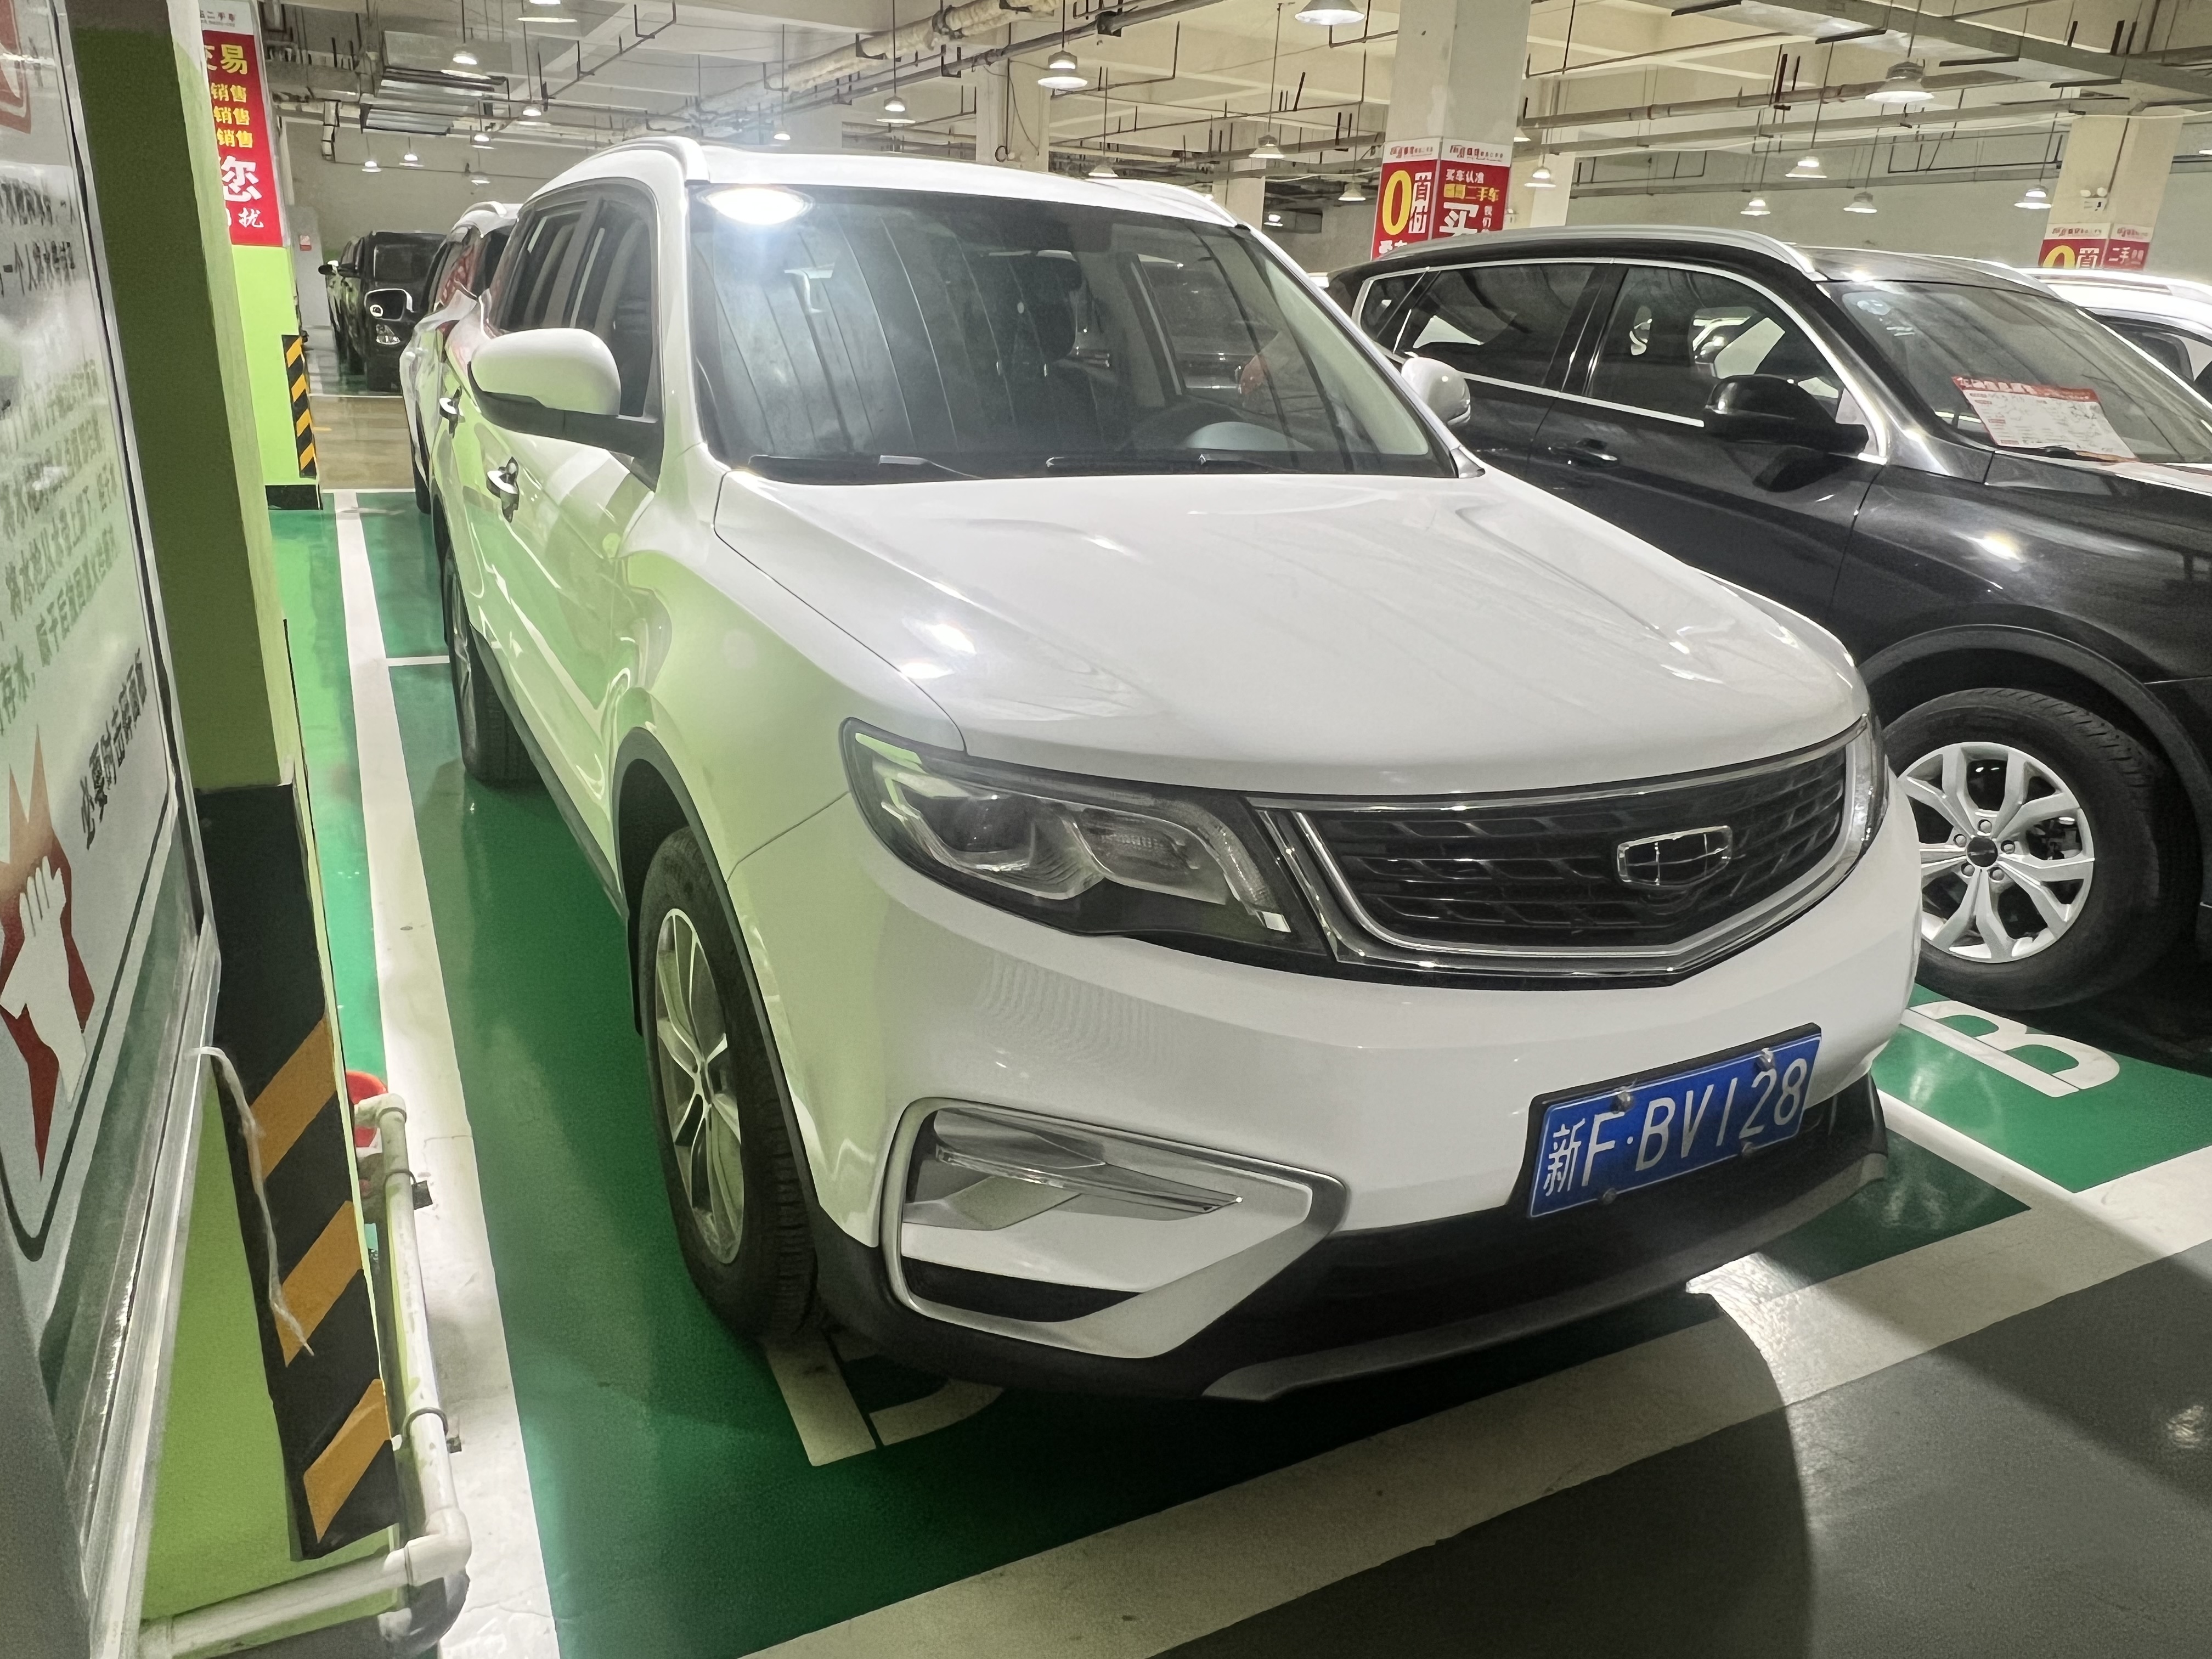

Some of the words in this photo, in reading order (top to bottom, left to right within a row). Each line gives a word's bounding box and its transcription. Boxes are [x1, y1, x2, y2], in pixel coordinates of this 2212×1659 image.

[217, 128, 253, 148] 销售
[1382, 170, 1412, 235] 0
[1900, 1000, 2120, 1097] B
